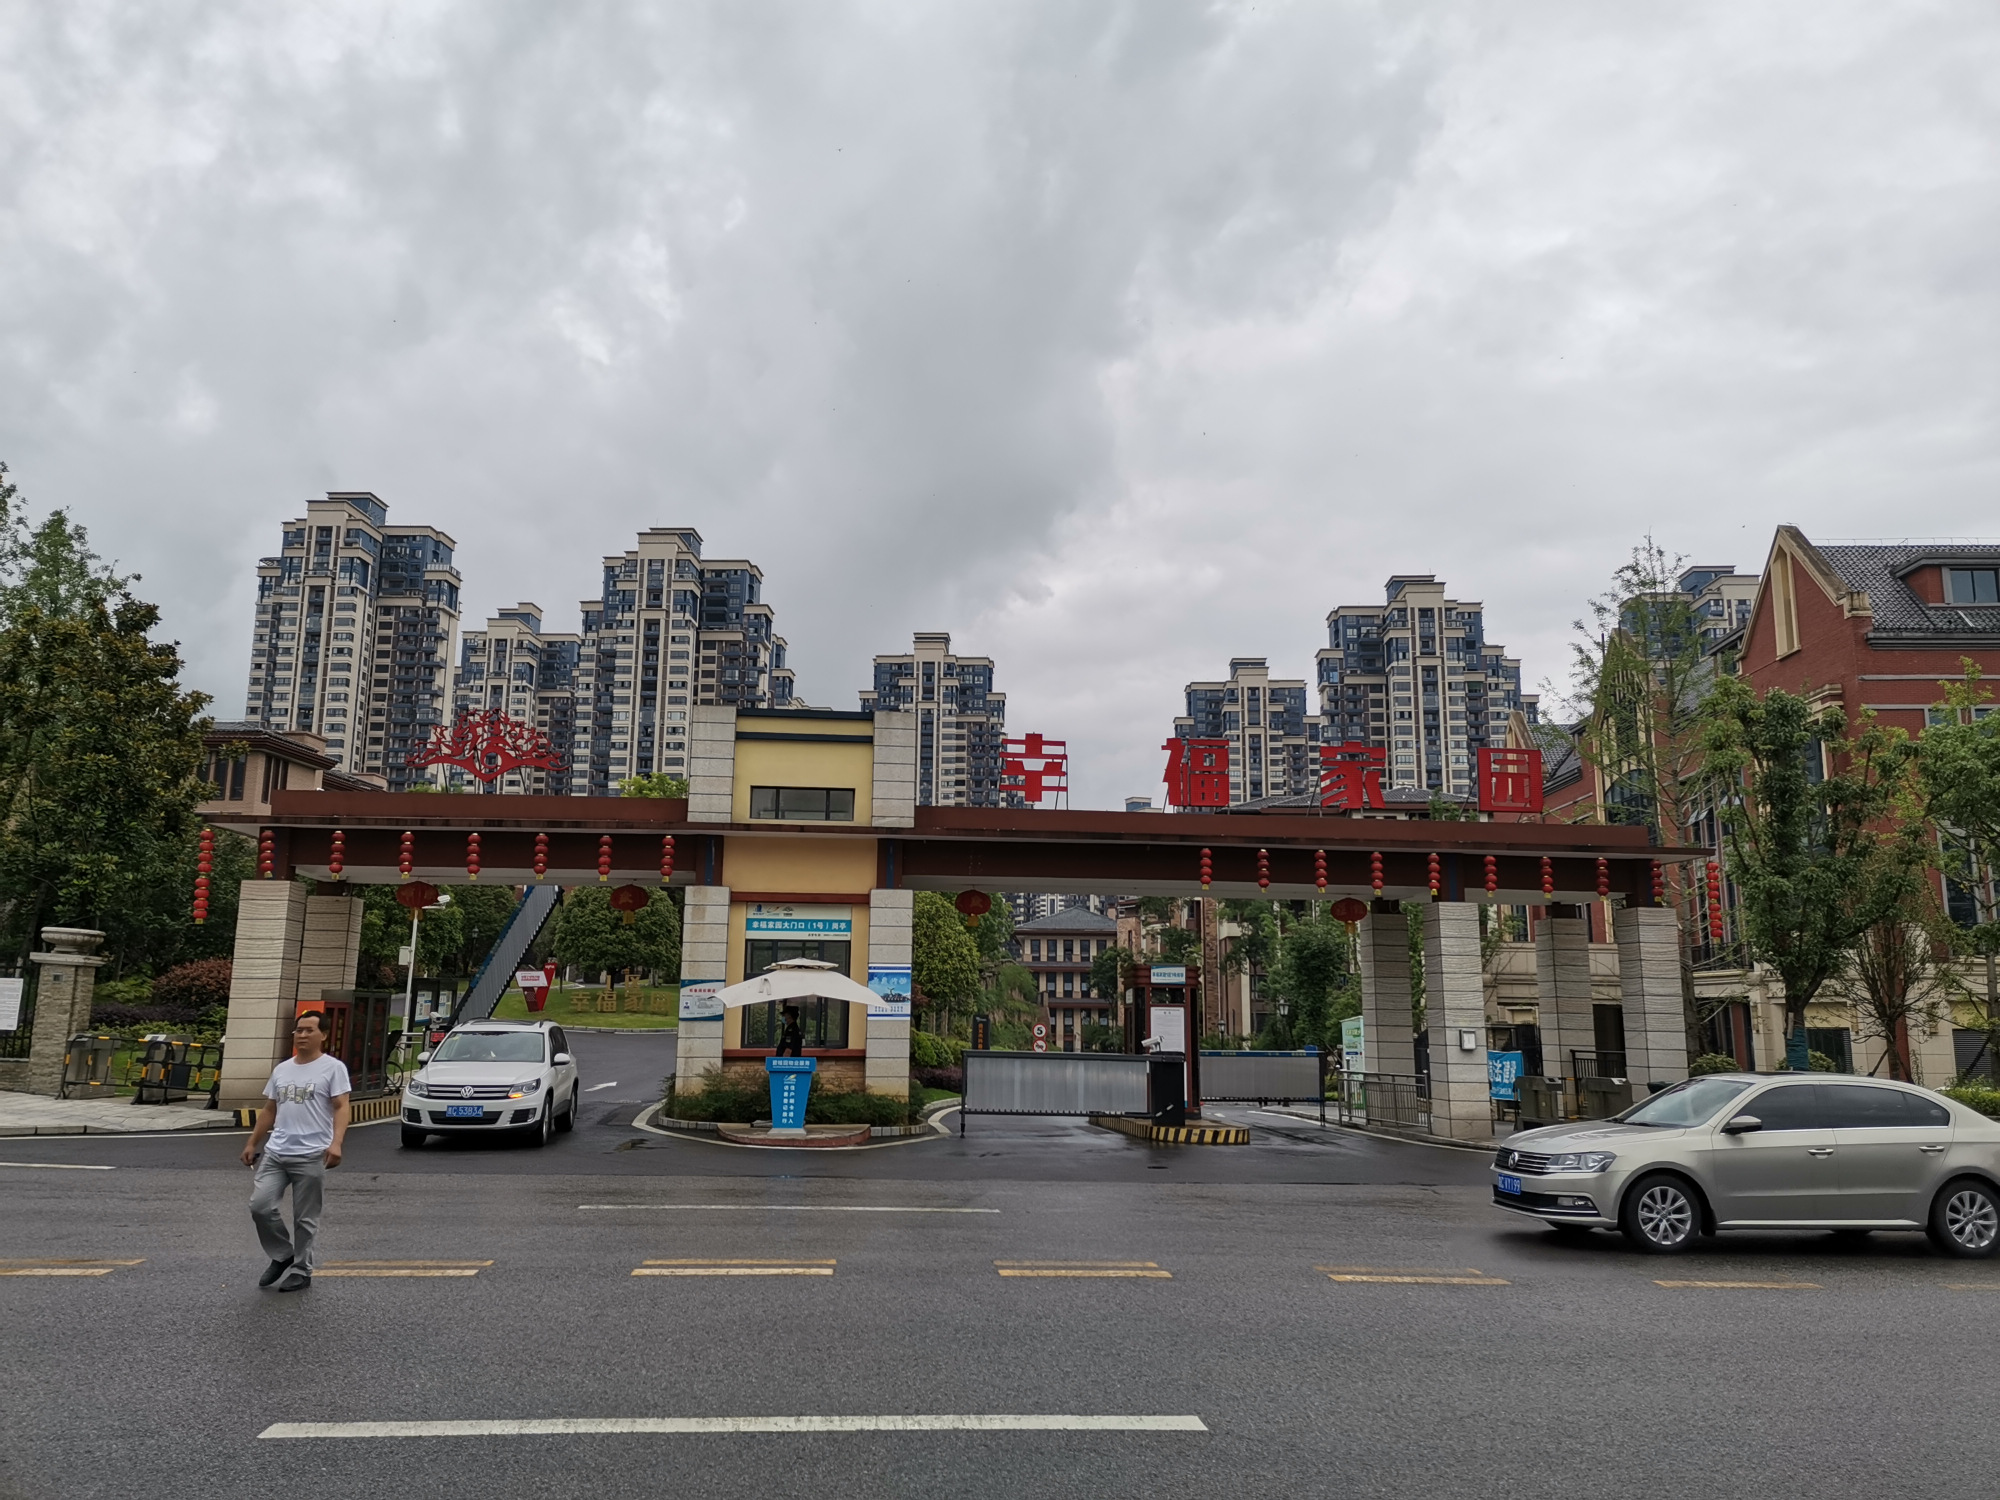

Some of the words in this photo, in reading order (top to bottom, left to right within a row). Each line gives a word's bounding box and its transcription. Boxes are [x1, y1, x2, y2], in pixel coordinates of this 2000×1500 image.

[1000, 734, 1543, 812] 幸福家园
[1036, 1026, 1043, 1036] 5
